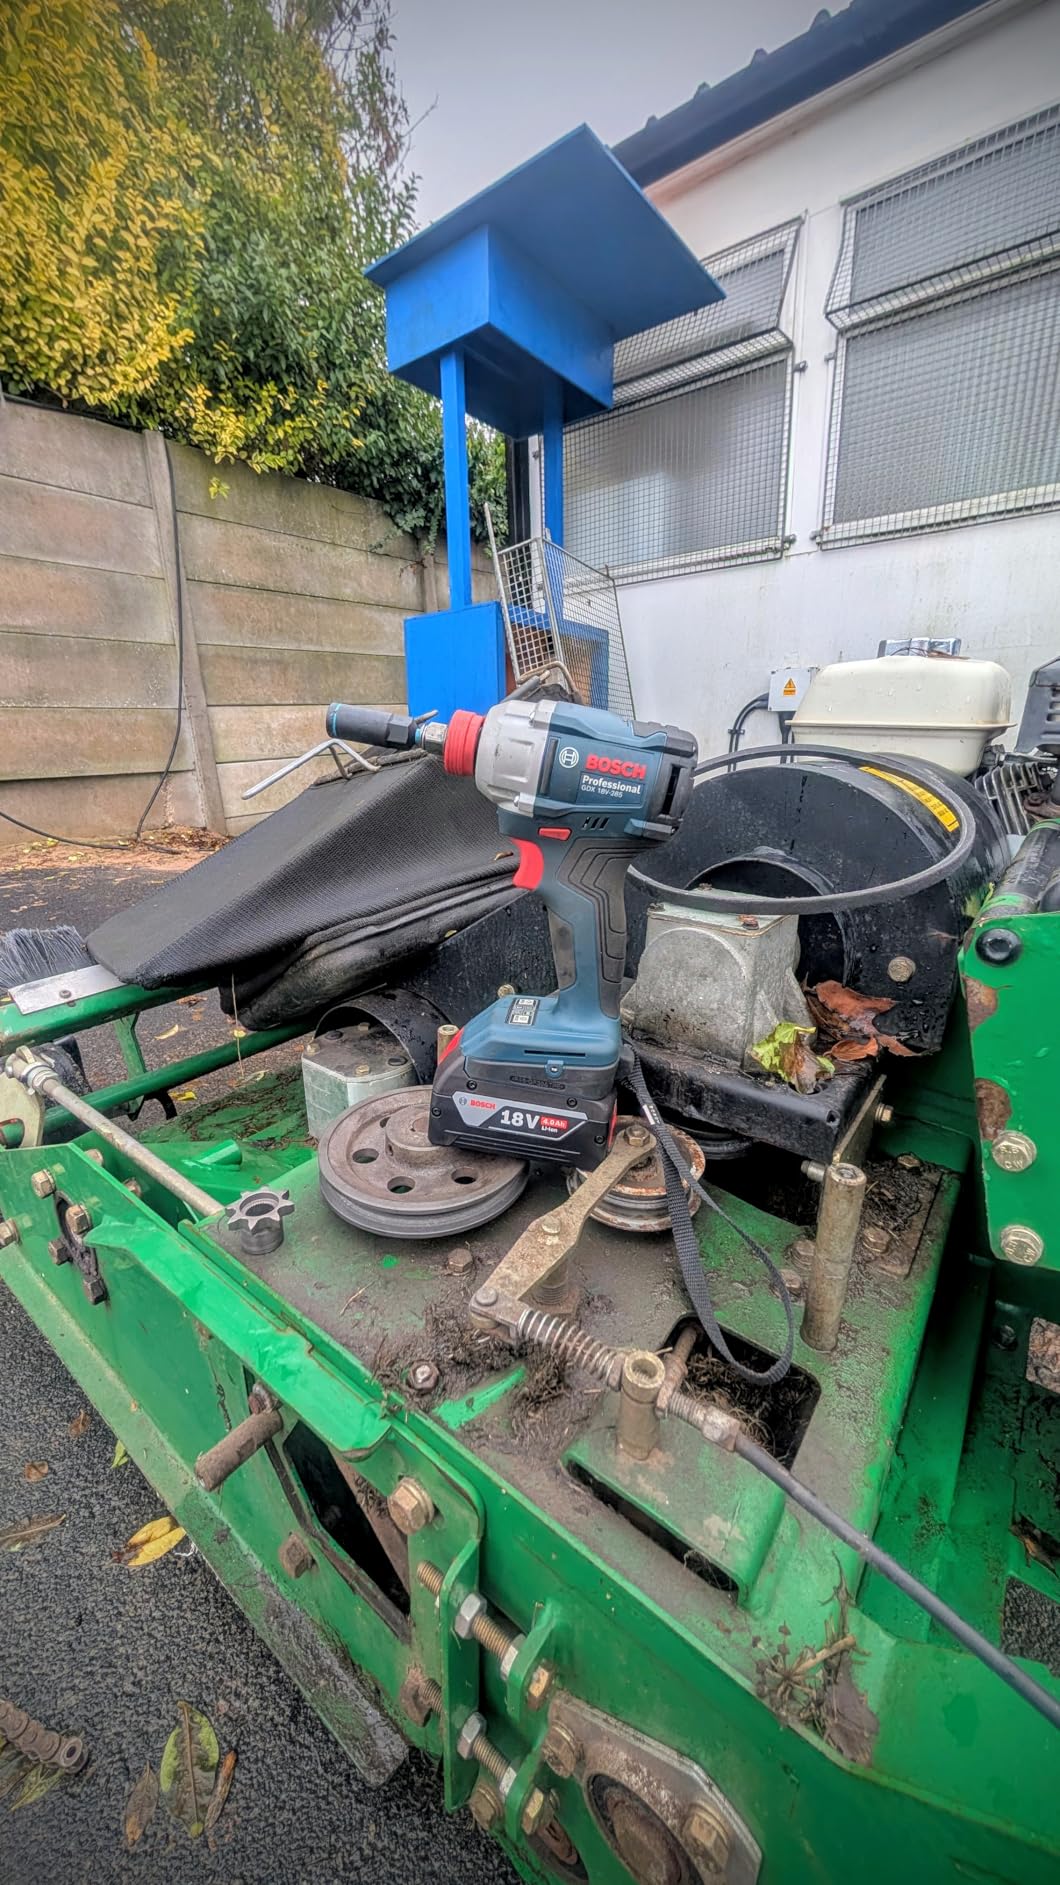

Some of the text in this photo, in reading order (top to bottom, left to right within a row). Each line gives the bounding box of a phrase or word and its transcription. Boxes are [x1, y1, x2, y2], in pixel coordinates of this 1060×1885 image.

[585, 753, 647, 779] BOSCH
[581, 785, 623, 798] GDX 18V-285
[582, 775, 641, 795] Professional
[470, 1099, 496, 1110] BOSCH
